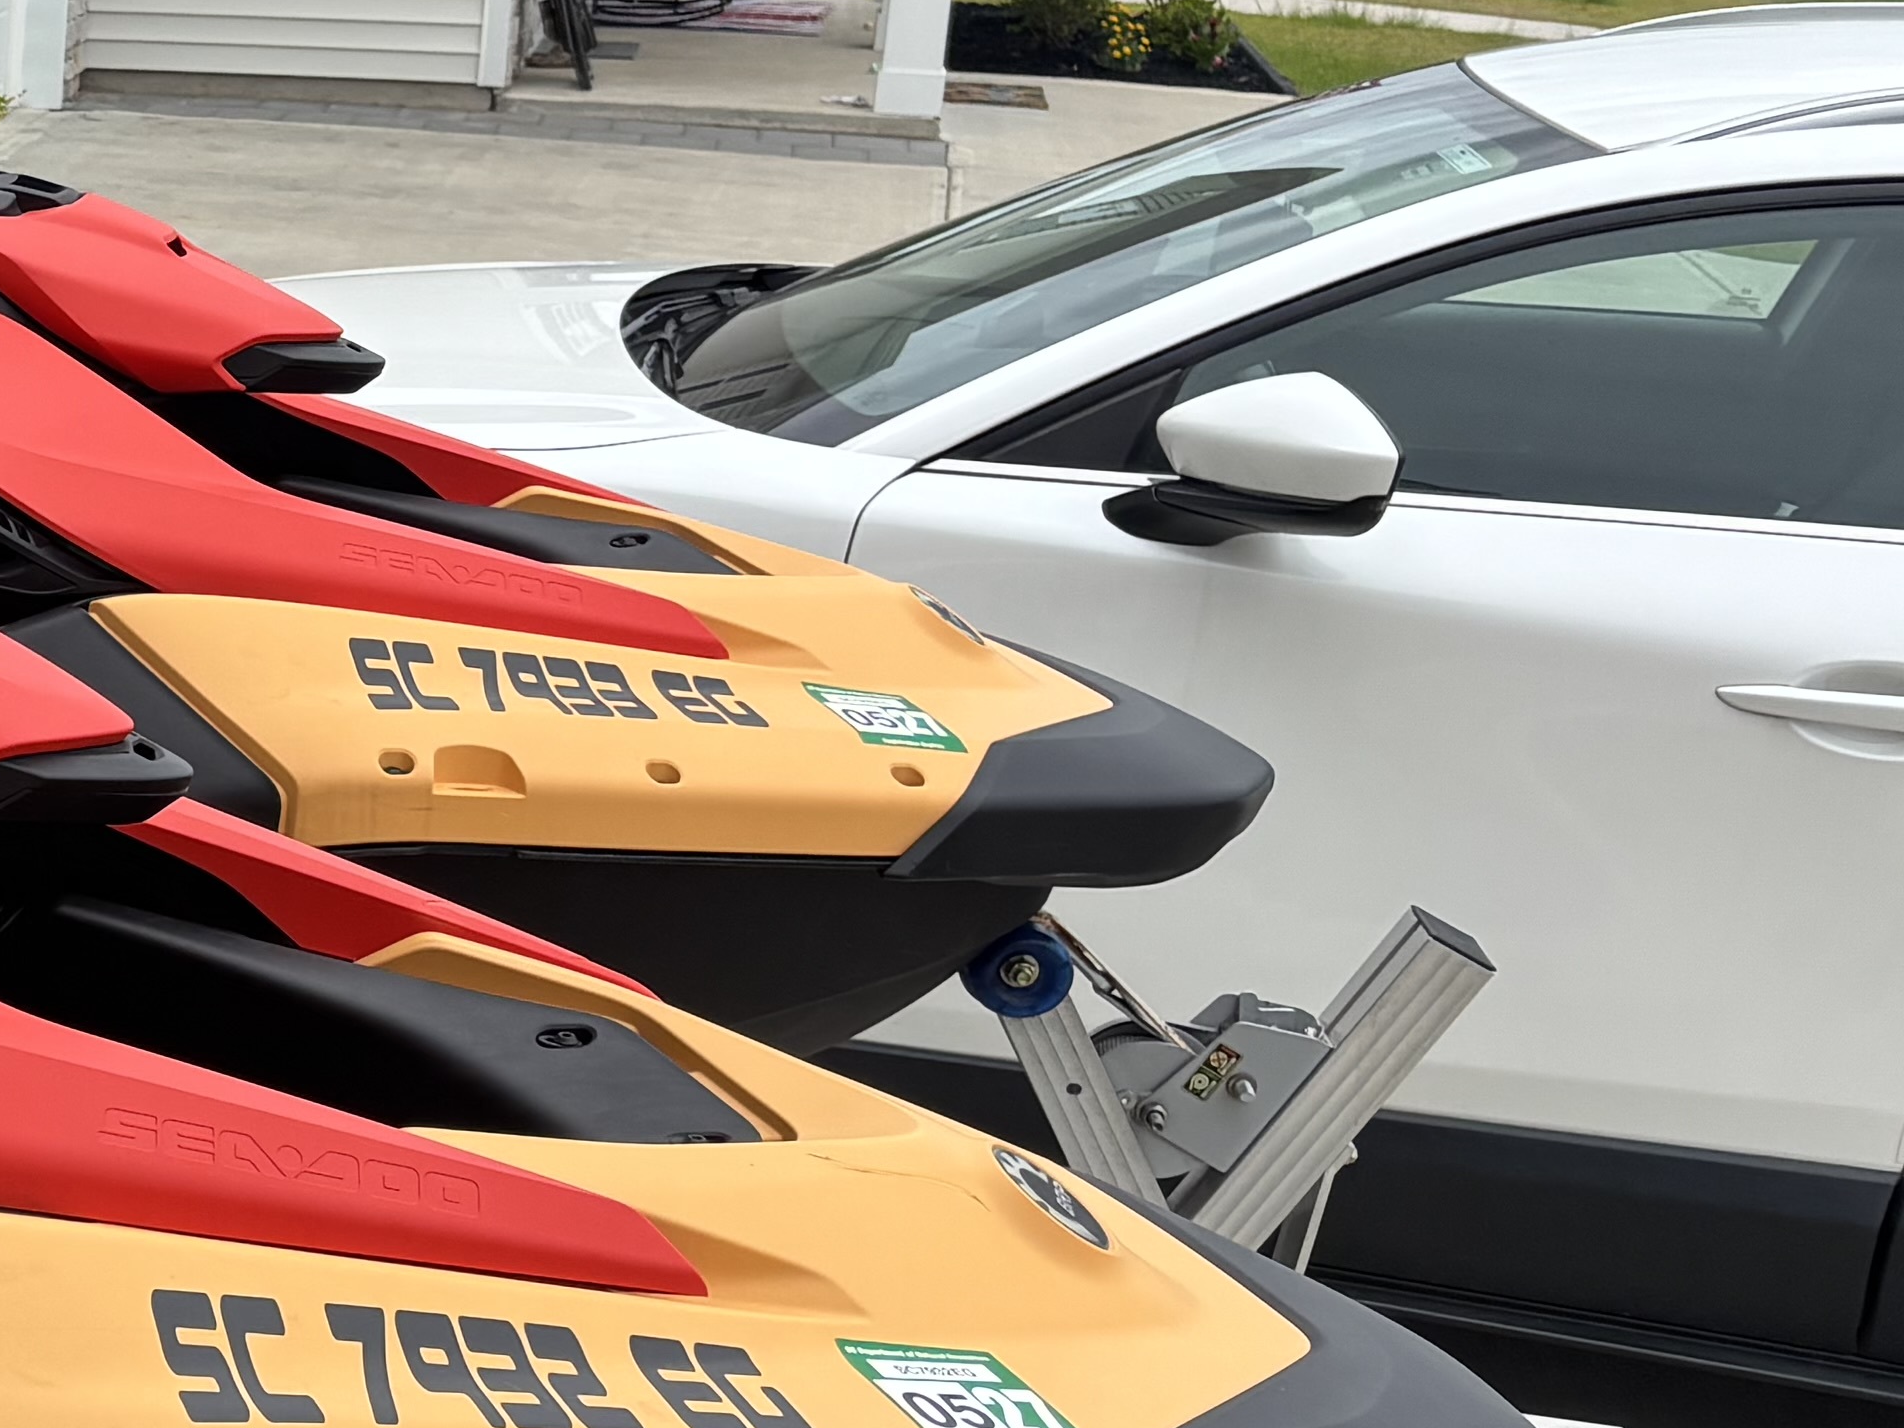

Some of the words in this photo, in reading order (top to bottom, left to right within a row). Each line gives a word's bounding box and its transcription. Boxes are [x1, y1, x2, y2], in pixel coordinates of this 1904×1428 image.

[349, 638, 459, 710] SC
[458, 647, 658, 719] 7933
[652, 670, 768, 727] EG
[842, 709, 899, 728] 05
[885, 708, 949, 736] 27
[151, 1289, 325, 1423] SC
